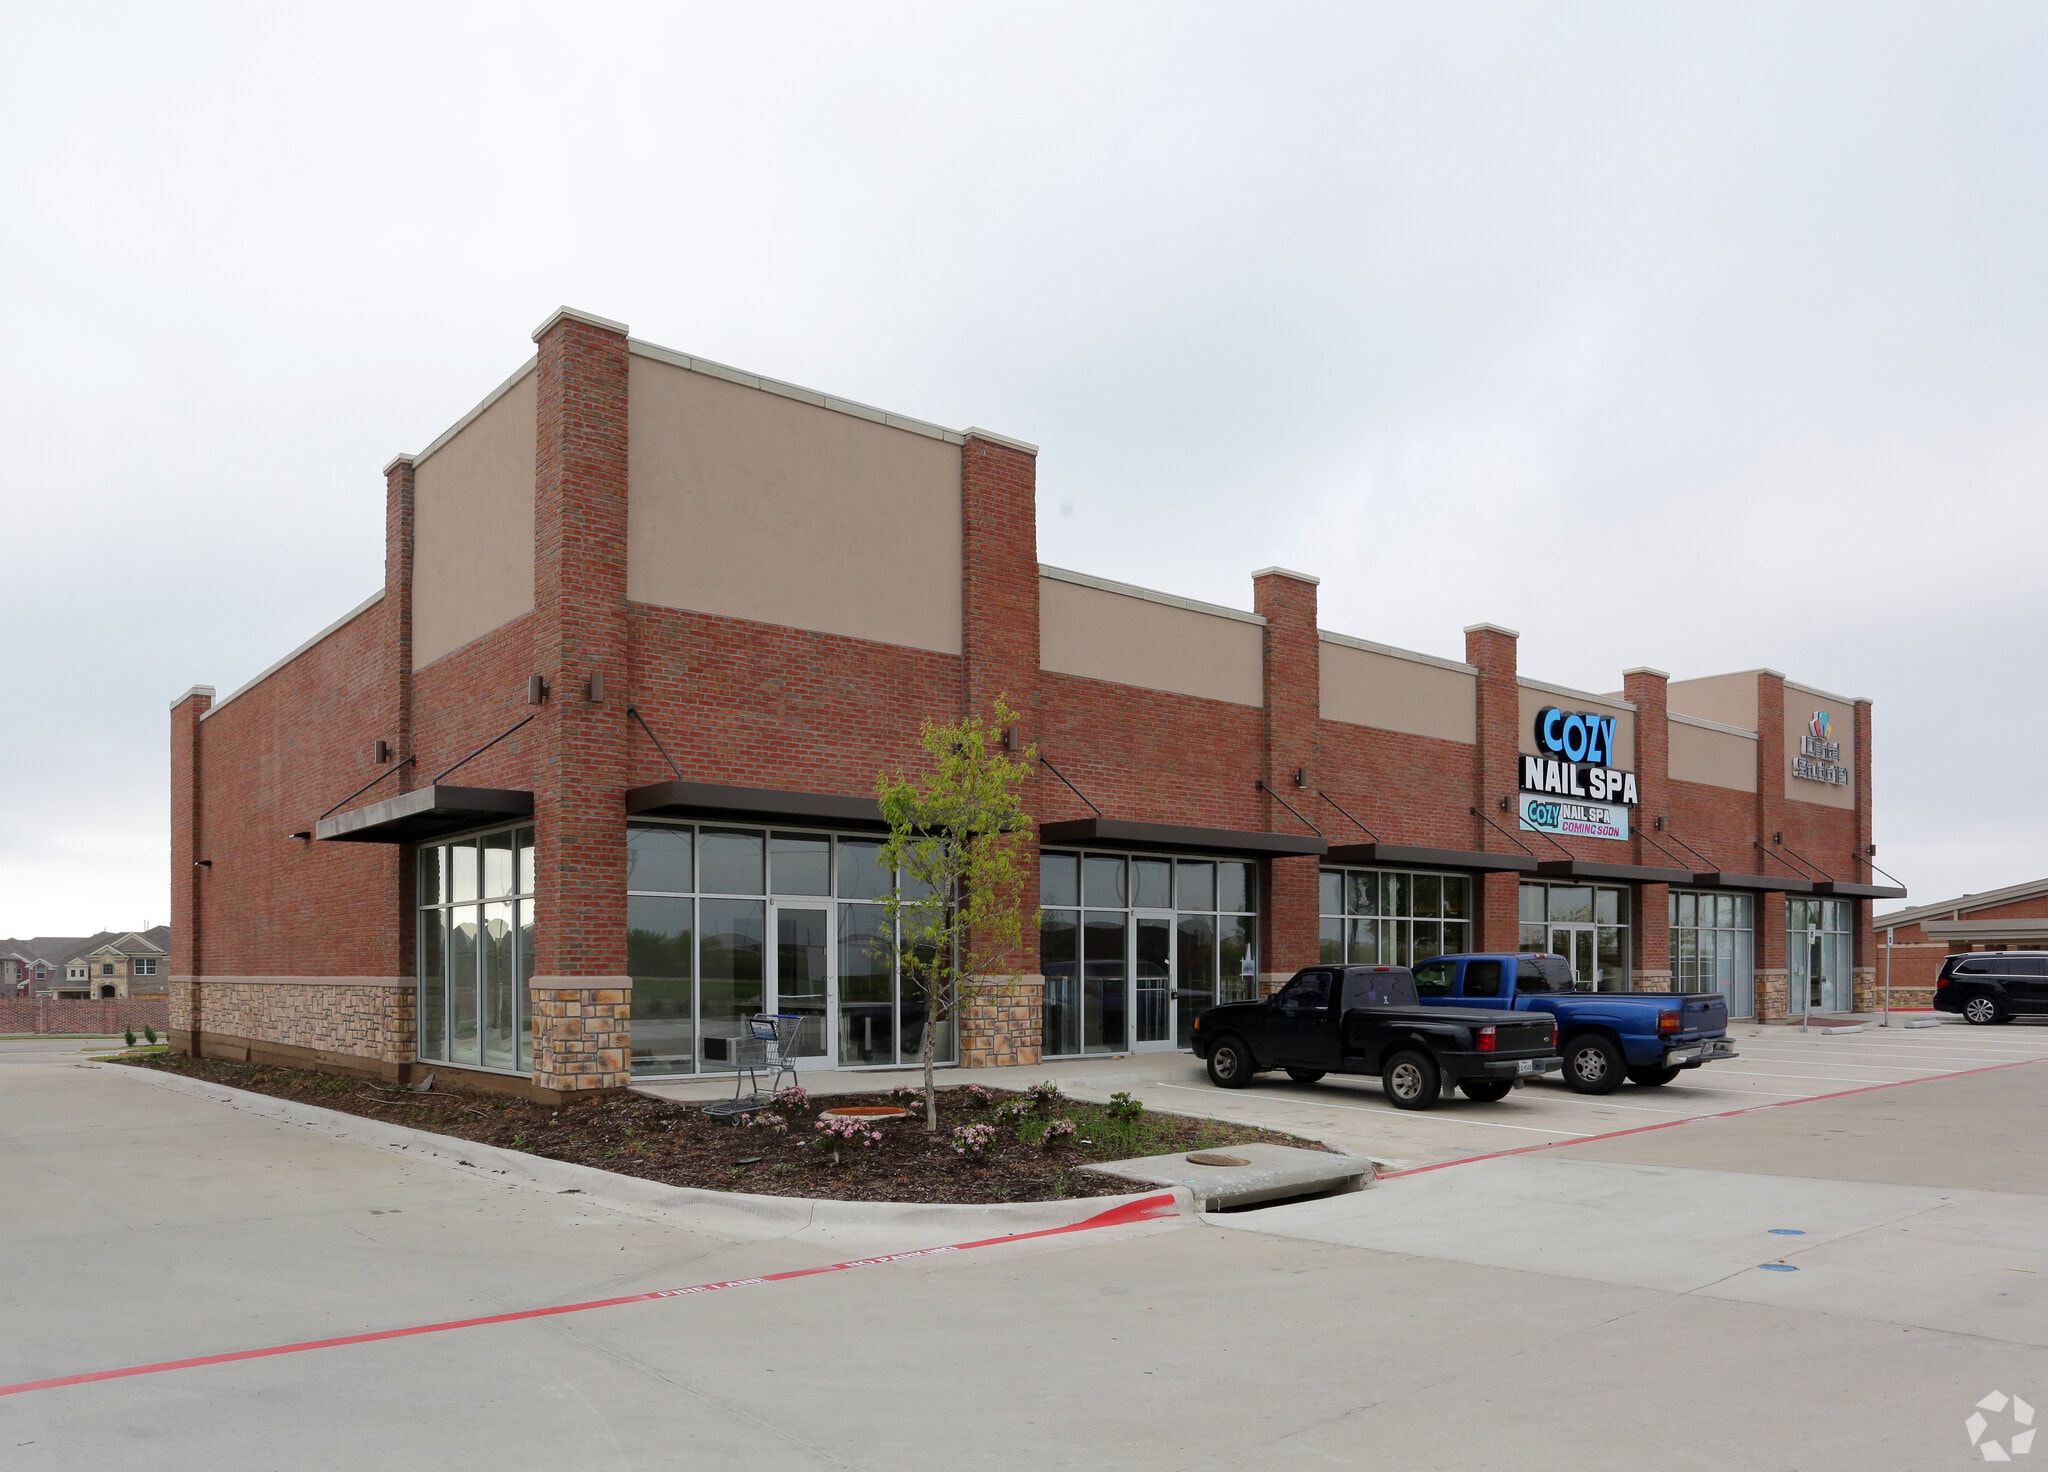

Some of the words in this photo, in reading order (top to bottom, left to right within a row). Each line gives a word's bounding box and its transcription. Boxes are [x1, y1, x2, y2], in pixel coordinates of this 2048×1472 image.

[1541, 707, 1617, 768] COZY
[1524, 755, 1586, 797] NAIL
[1589, 766, 1639, 804] SPA
[1528, 800, 1561, 828] COZY
[1562, 803, 1588, 822] NAIL
[1588, 807, 1612, 824] SPA
[1562, 821, 1597, 835] COMING
[1597, 823, 1620, 838] SOON
[843, 1259, 876, 1268] NO
